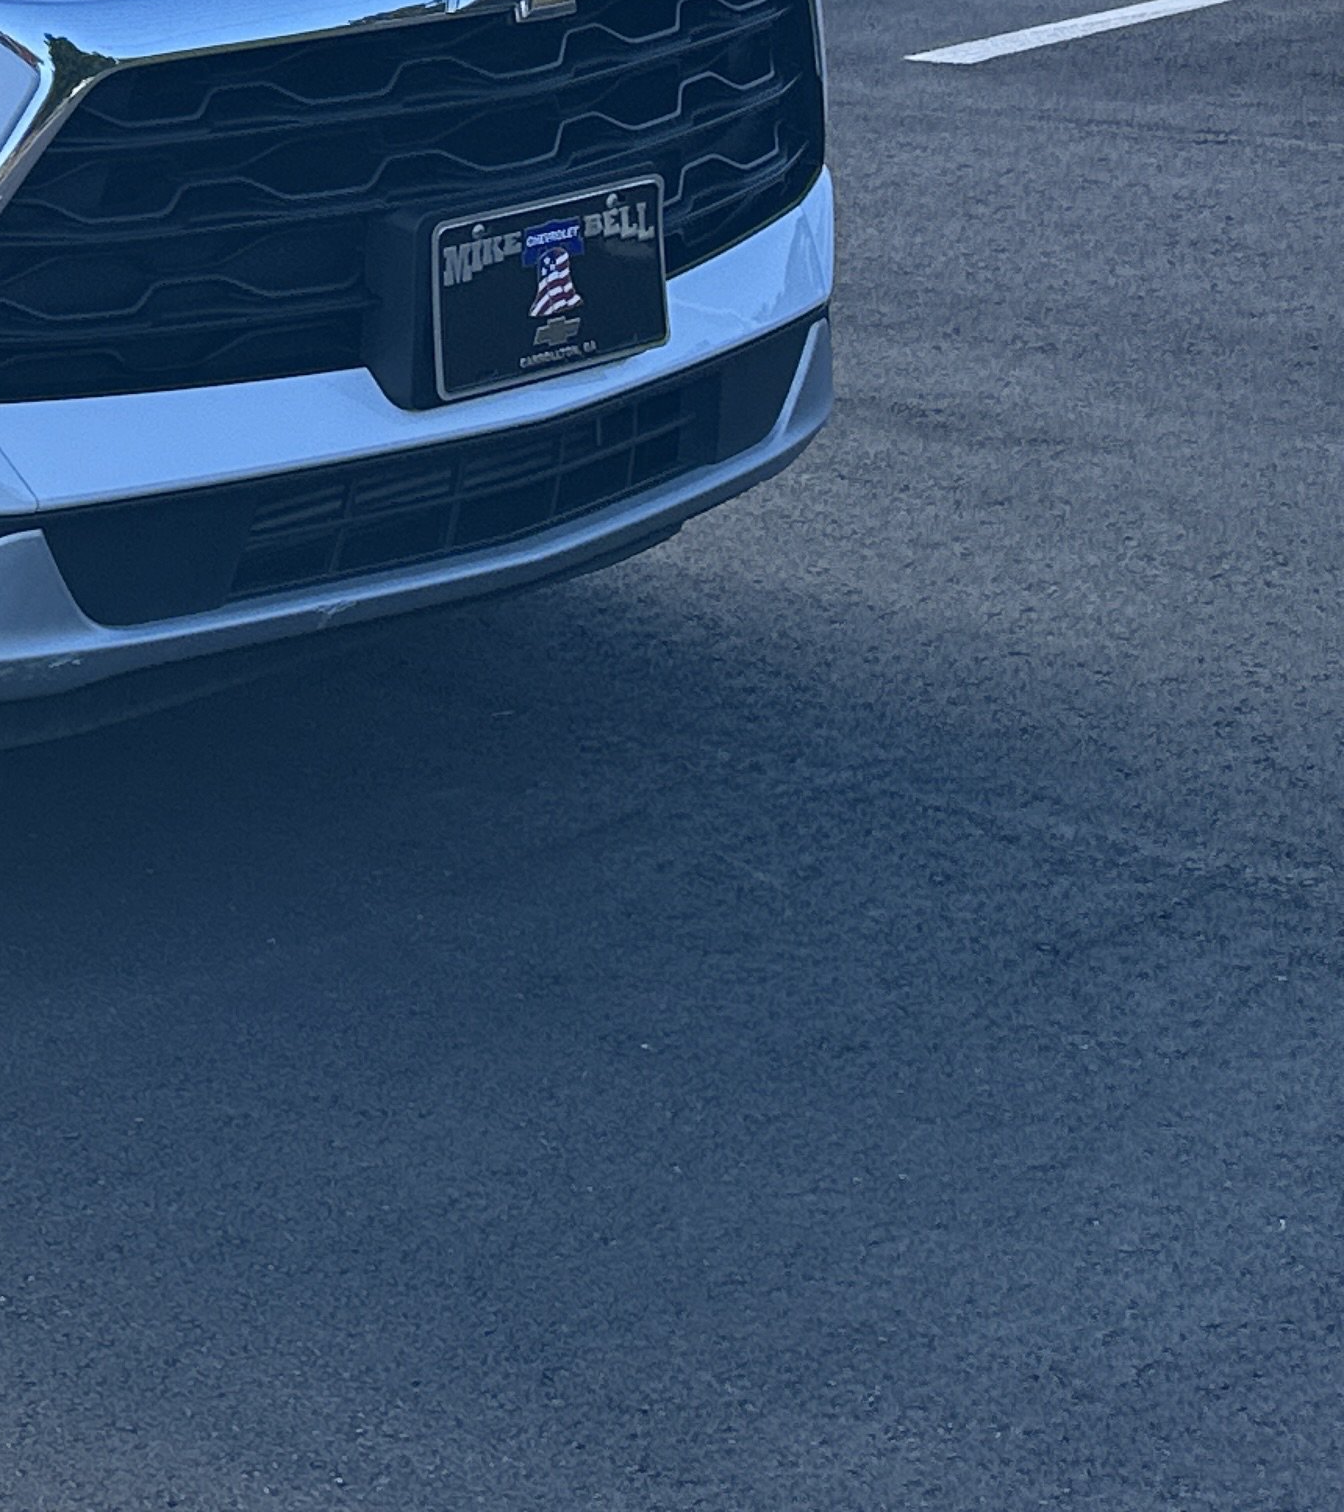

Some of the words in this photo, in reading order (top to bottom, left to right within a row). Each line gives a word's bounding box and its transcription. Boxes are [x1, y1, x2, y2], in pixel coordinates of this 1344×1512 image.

[443, 231, 522, 286] MIKE
[526, 224, 580, 248] CHEVROLET
[584, 202, 655, 240] BELL
